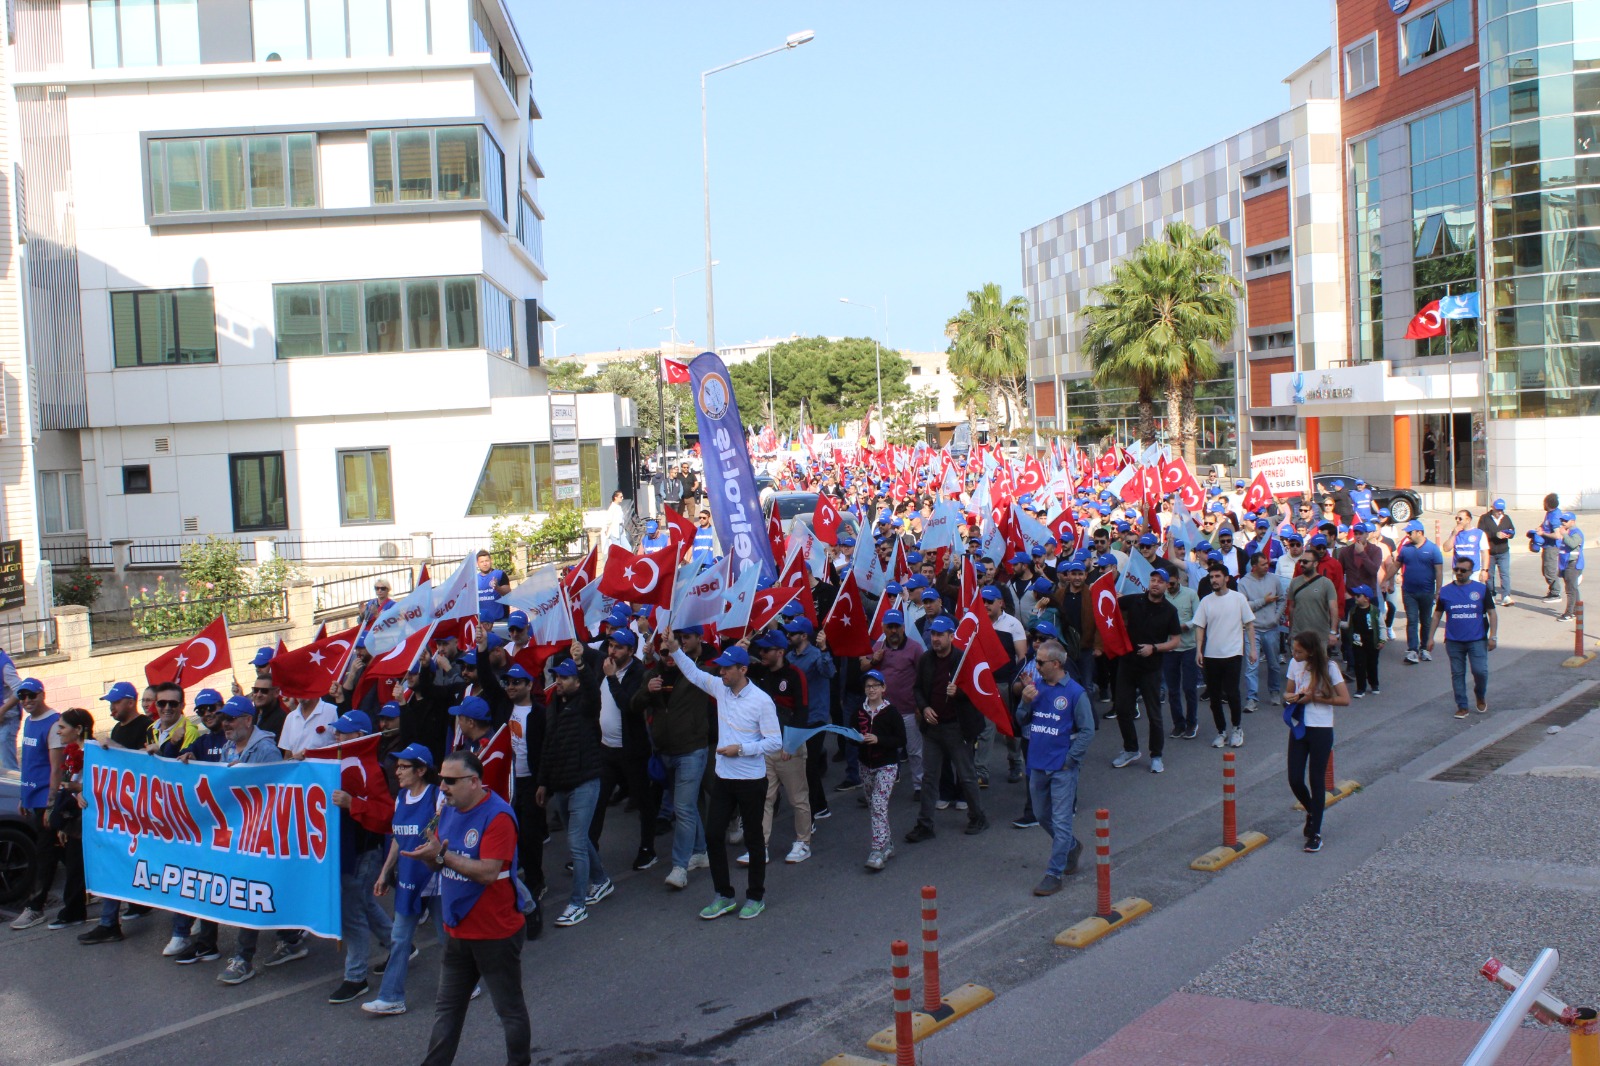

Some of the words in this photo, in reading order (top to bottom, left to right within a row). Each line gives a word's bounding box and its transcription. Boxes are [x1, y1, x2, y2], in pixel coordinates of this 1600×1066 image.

[1265, 468, 1285, 478] ERNEĞİ
[1031, 724, 1059, 736] ENDİKASI
[91, 765, 202, 856] YAŞASIN
[195, 774, 234, 851] 1
[230, 783, 327, 863] MAYIS
[393, 824, 419, 835] -PETDER
[132, 860, 276, 913] A-PETDER
